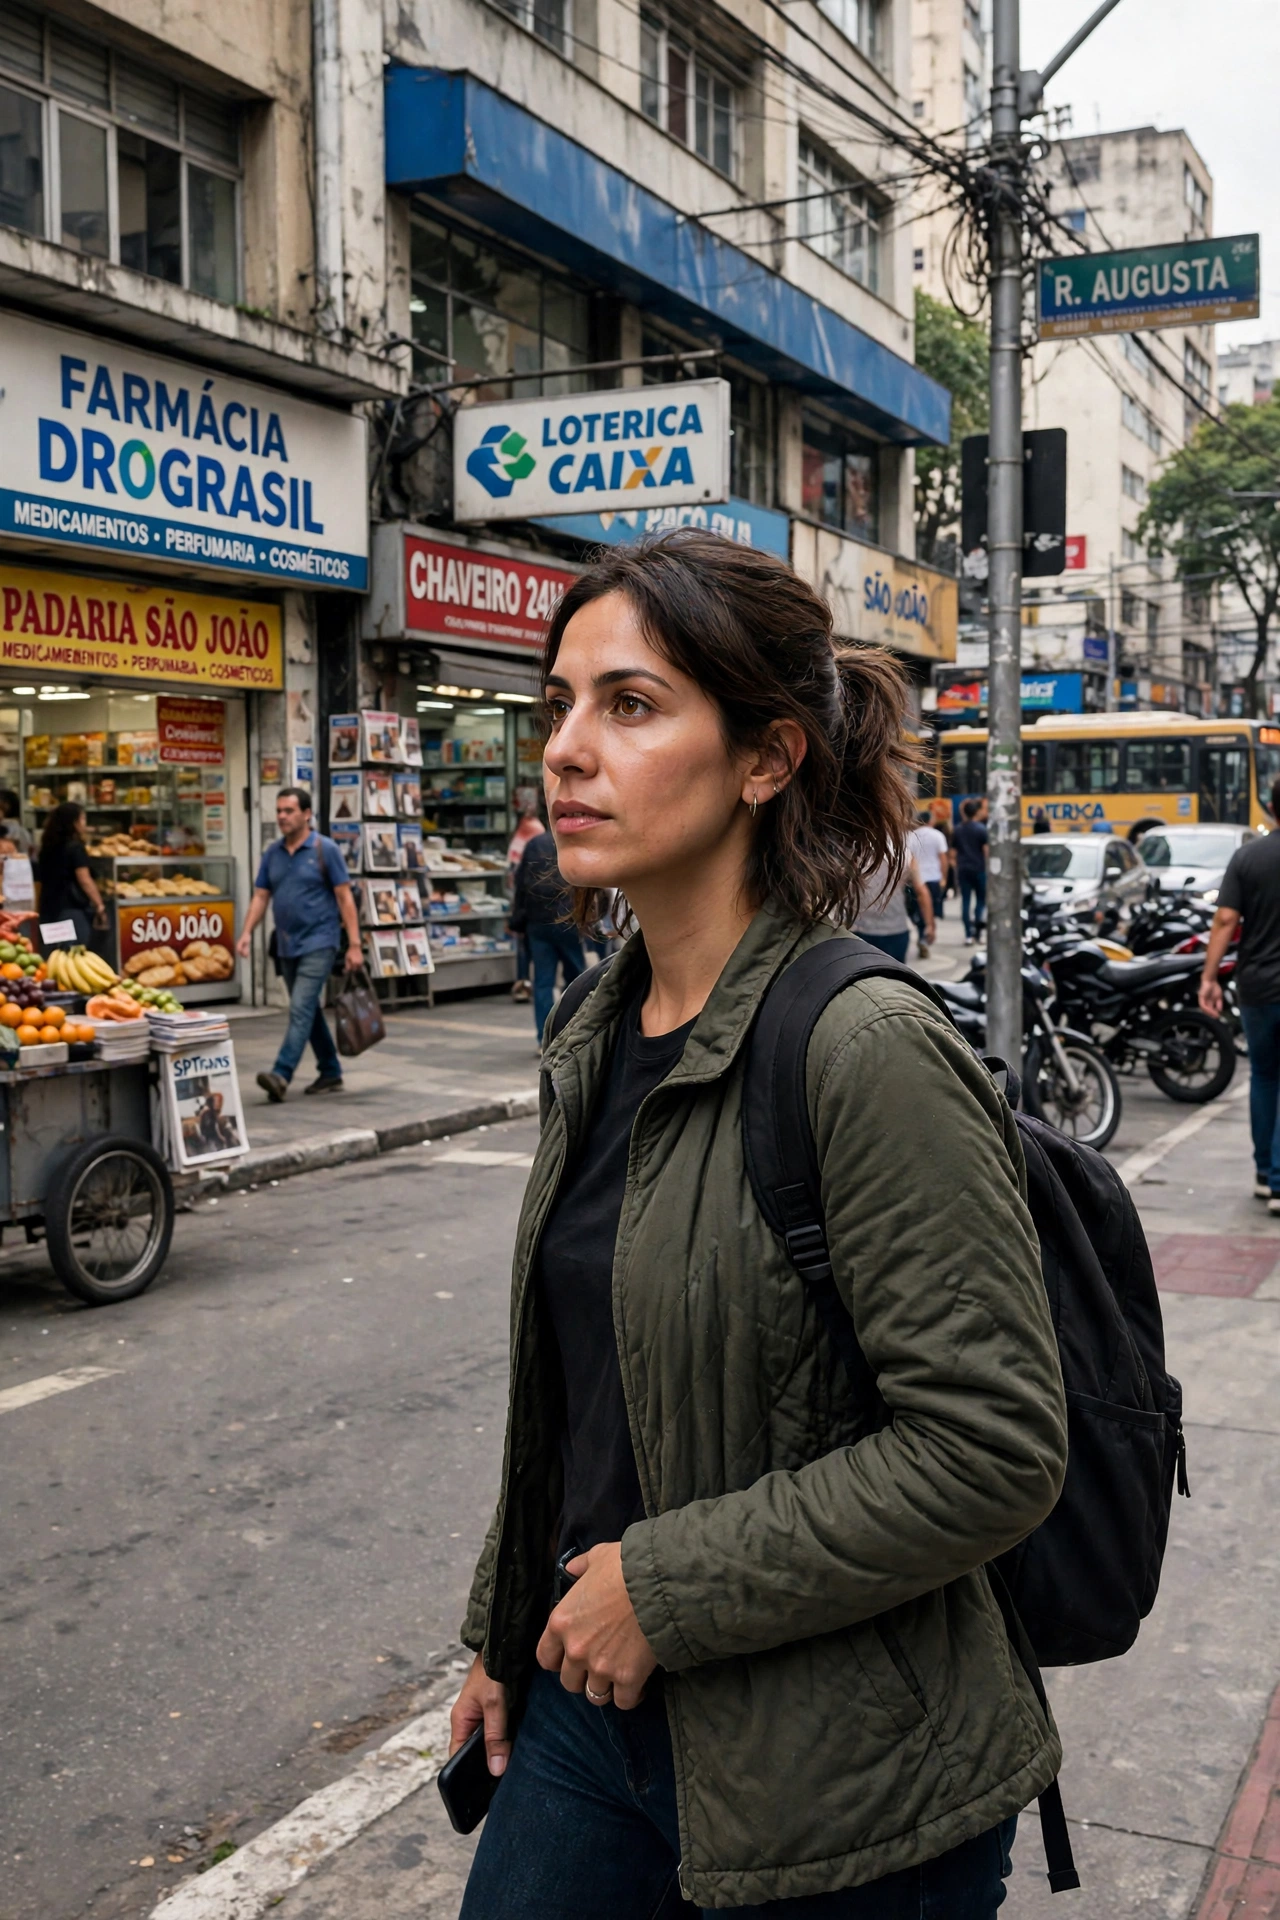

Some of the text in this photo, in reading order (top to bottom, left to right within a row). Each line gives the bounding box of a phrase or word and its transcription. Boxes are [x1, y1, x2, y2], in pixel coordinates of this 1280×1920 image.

[1055, 255, 1230, 308] R. AUGUSTA
[60, 354, 288, 463] FARMÁCIA
[542, 404, 703, 447] LOTERICA
[38, 417, 324, 535] DROGRASIL
[549, 446, 695, 494] CAIXA
[14, 499, 349, 580] MEDICAMENTOS PERFUMARIA COSMÉTICOS
[410, 550, 521, 616] CHAVEIRO
[2, 586, 269, 660] PADARIA SÃO JOÃO
[132, 908, 223, 943] SÃO JOÃO
